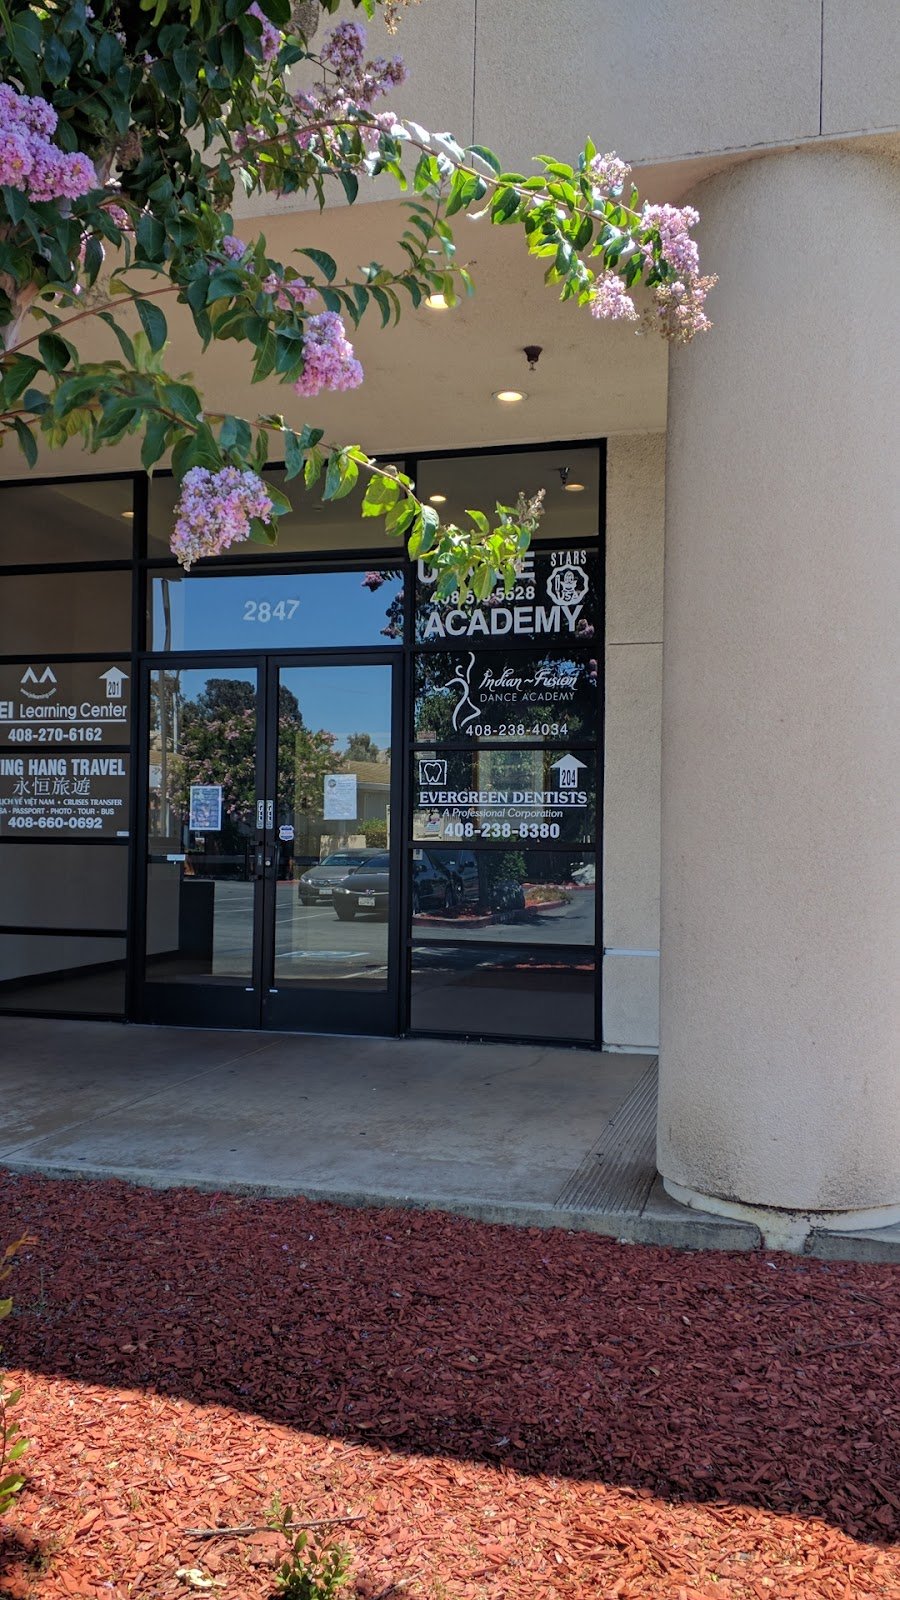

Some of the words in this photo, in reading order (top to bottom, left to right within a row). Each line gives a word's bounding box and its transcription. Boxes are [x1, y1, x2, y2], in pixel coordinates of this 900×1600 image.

[550, 550, 587, 567] STARS
[243, 599, 300, 623] 2847
[423, 605, 584, 637] ACADEMY
[107, 681, 120, 695] 201
[480, 692, 517, 703] DANCE
[522, 692, 575, 702] ACADEMY
[20, 703, 77, 720] Learning
[80, 702, 127, 718] Center
[8, 727, 103, 742] 408-270-6162
[466, 723, 569, 737] 408-238-4034
[28, 758, 67, 776] HANG
[71, 758, 126, 776] TRAVEL
[561, 769, 576, 786] 204
[62, 798, 89, 806] CRUISES
[90, 798, 123, 806] TRANSFER
[419, 791, 508, 804] EVERGREEN
[512, 791, 588, 804] DENTISTS
[12, 807, 45, 815] PASSPORT
[50, 807, 73, 815] PHOTO
[78, 807, 96, 815] TOUR
[101, 807, 115, 815] BUS
[442, 808, 450, 817] A
[452, 807, 506, 819] Professional
[507, 808, 564, 819] Corporation
[8, 816, 103, 829] 408-660-0692
[444, 822, 560, 838] 408-238-8380
